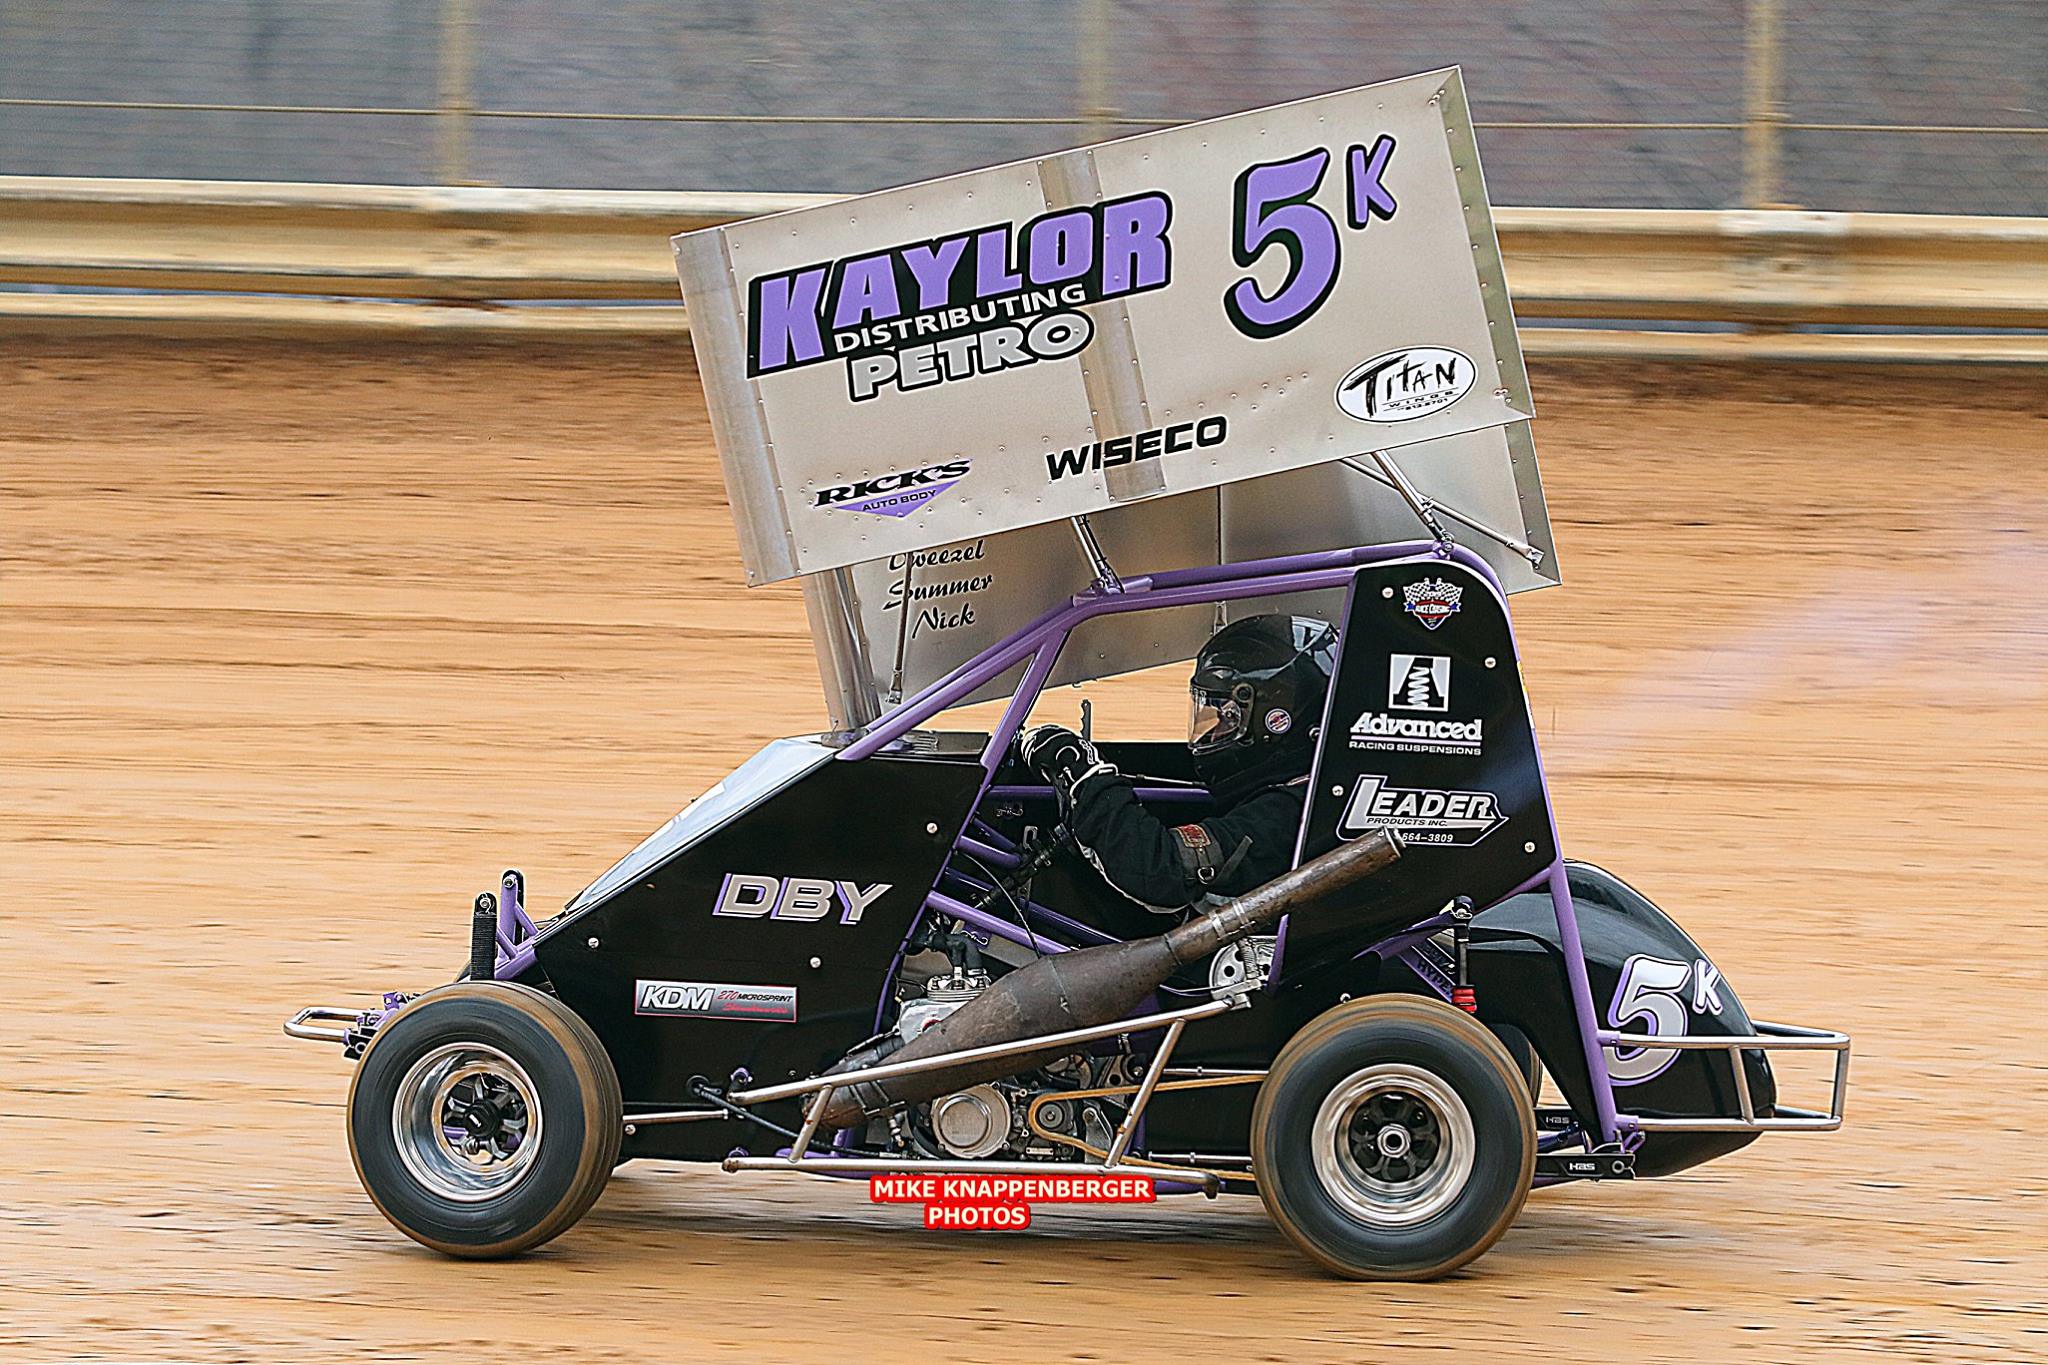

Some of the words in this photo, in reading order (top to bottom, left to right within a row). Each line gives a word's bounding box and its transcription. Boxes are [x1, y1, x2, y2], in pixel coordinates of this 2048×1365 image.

[747, 191, 1173, 378] KAYLOR
[834, 284, 1086, 352] DISTRIBUTING
[848, 311, 1095, 401] PETRO
[1045, 416, 1226, 481] WISECO
[815, 459, 970, 507] RICK'S
[862, 499, 898, 511] AUTO
[901, 489, 937, 503] BODY
[882, 574, 992, 610] Summer
[911, 602, 975, 639] Nick
[1350, 712, 1482, 741] Advanced
[1349, 741, 1394, 751] RACING
[1396, 744, 1481, 756] SUSPENSIONS
[1346, 779, 1496, 828] LEADER
[1366, 817, 1425, 826] PRODUCTS
[712, 873, 893, 925] DBY
[641, 985, 717, 1011] KDM
[718, 990, 739, 1000] 270
[737, 993, 793, 1002] MICROSPRINT
